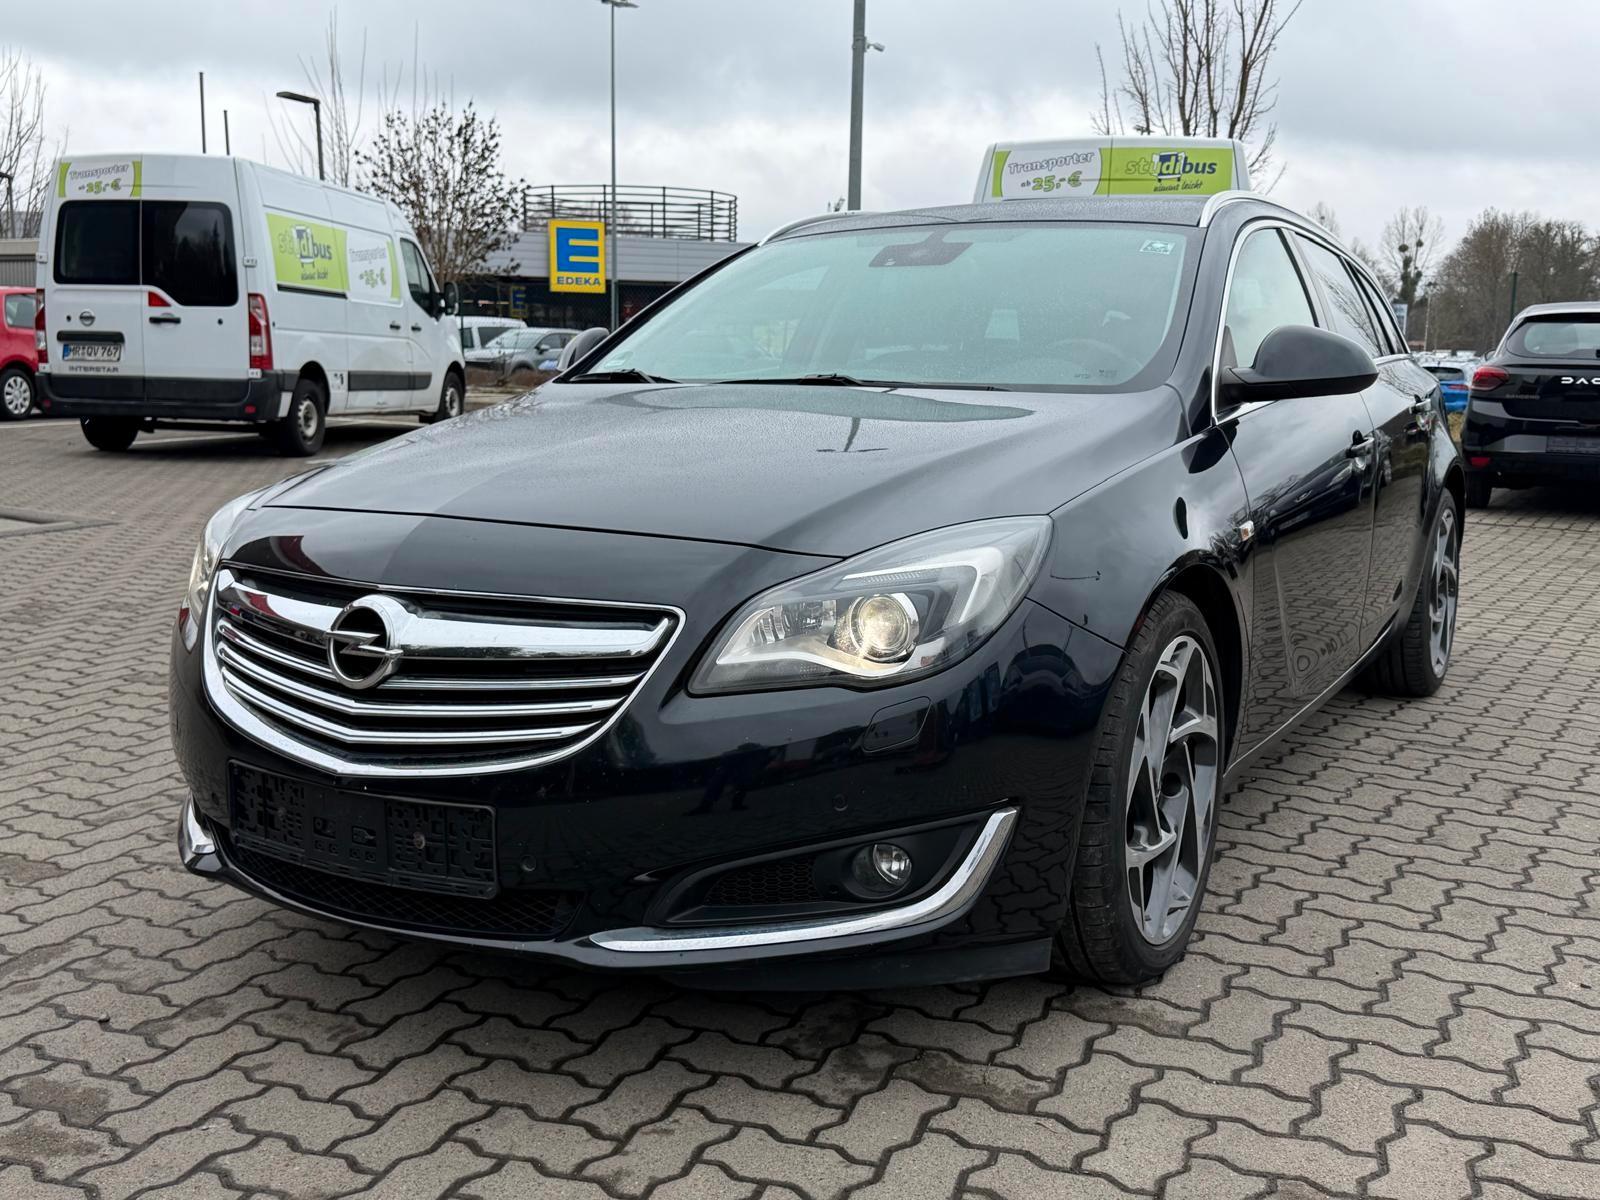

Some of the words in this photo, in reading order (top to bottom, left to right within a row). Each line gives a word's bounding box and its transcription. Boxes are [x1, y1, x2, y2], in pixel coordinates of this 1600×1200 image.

[1008, 152, 1094, 174] Transporter
[1125, 152, 1217, 176] studibus
[69, 165, 129, 179] Transporter
[1020, 180, 1031, 188] ab
[1067, 170, 1083, 188] €
[556, 228, 599, 273] E
[556, 276, 600, 285] EDEKA
[101, 347, 119, 358] 767
[69, 365, 119, 373] INTERSTAR
